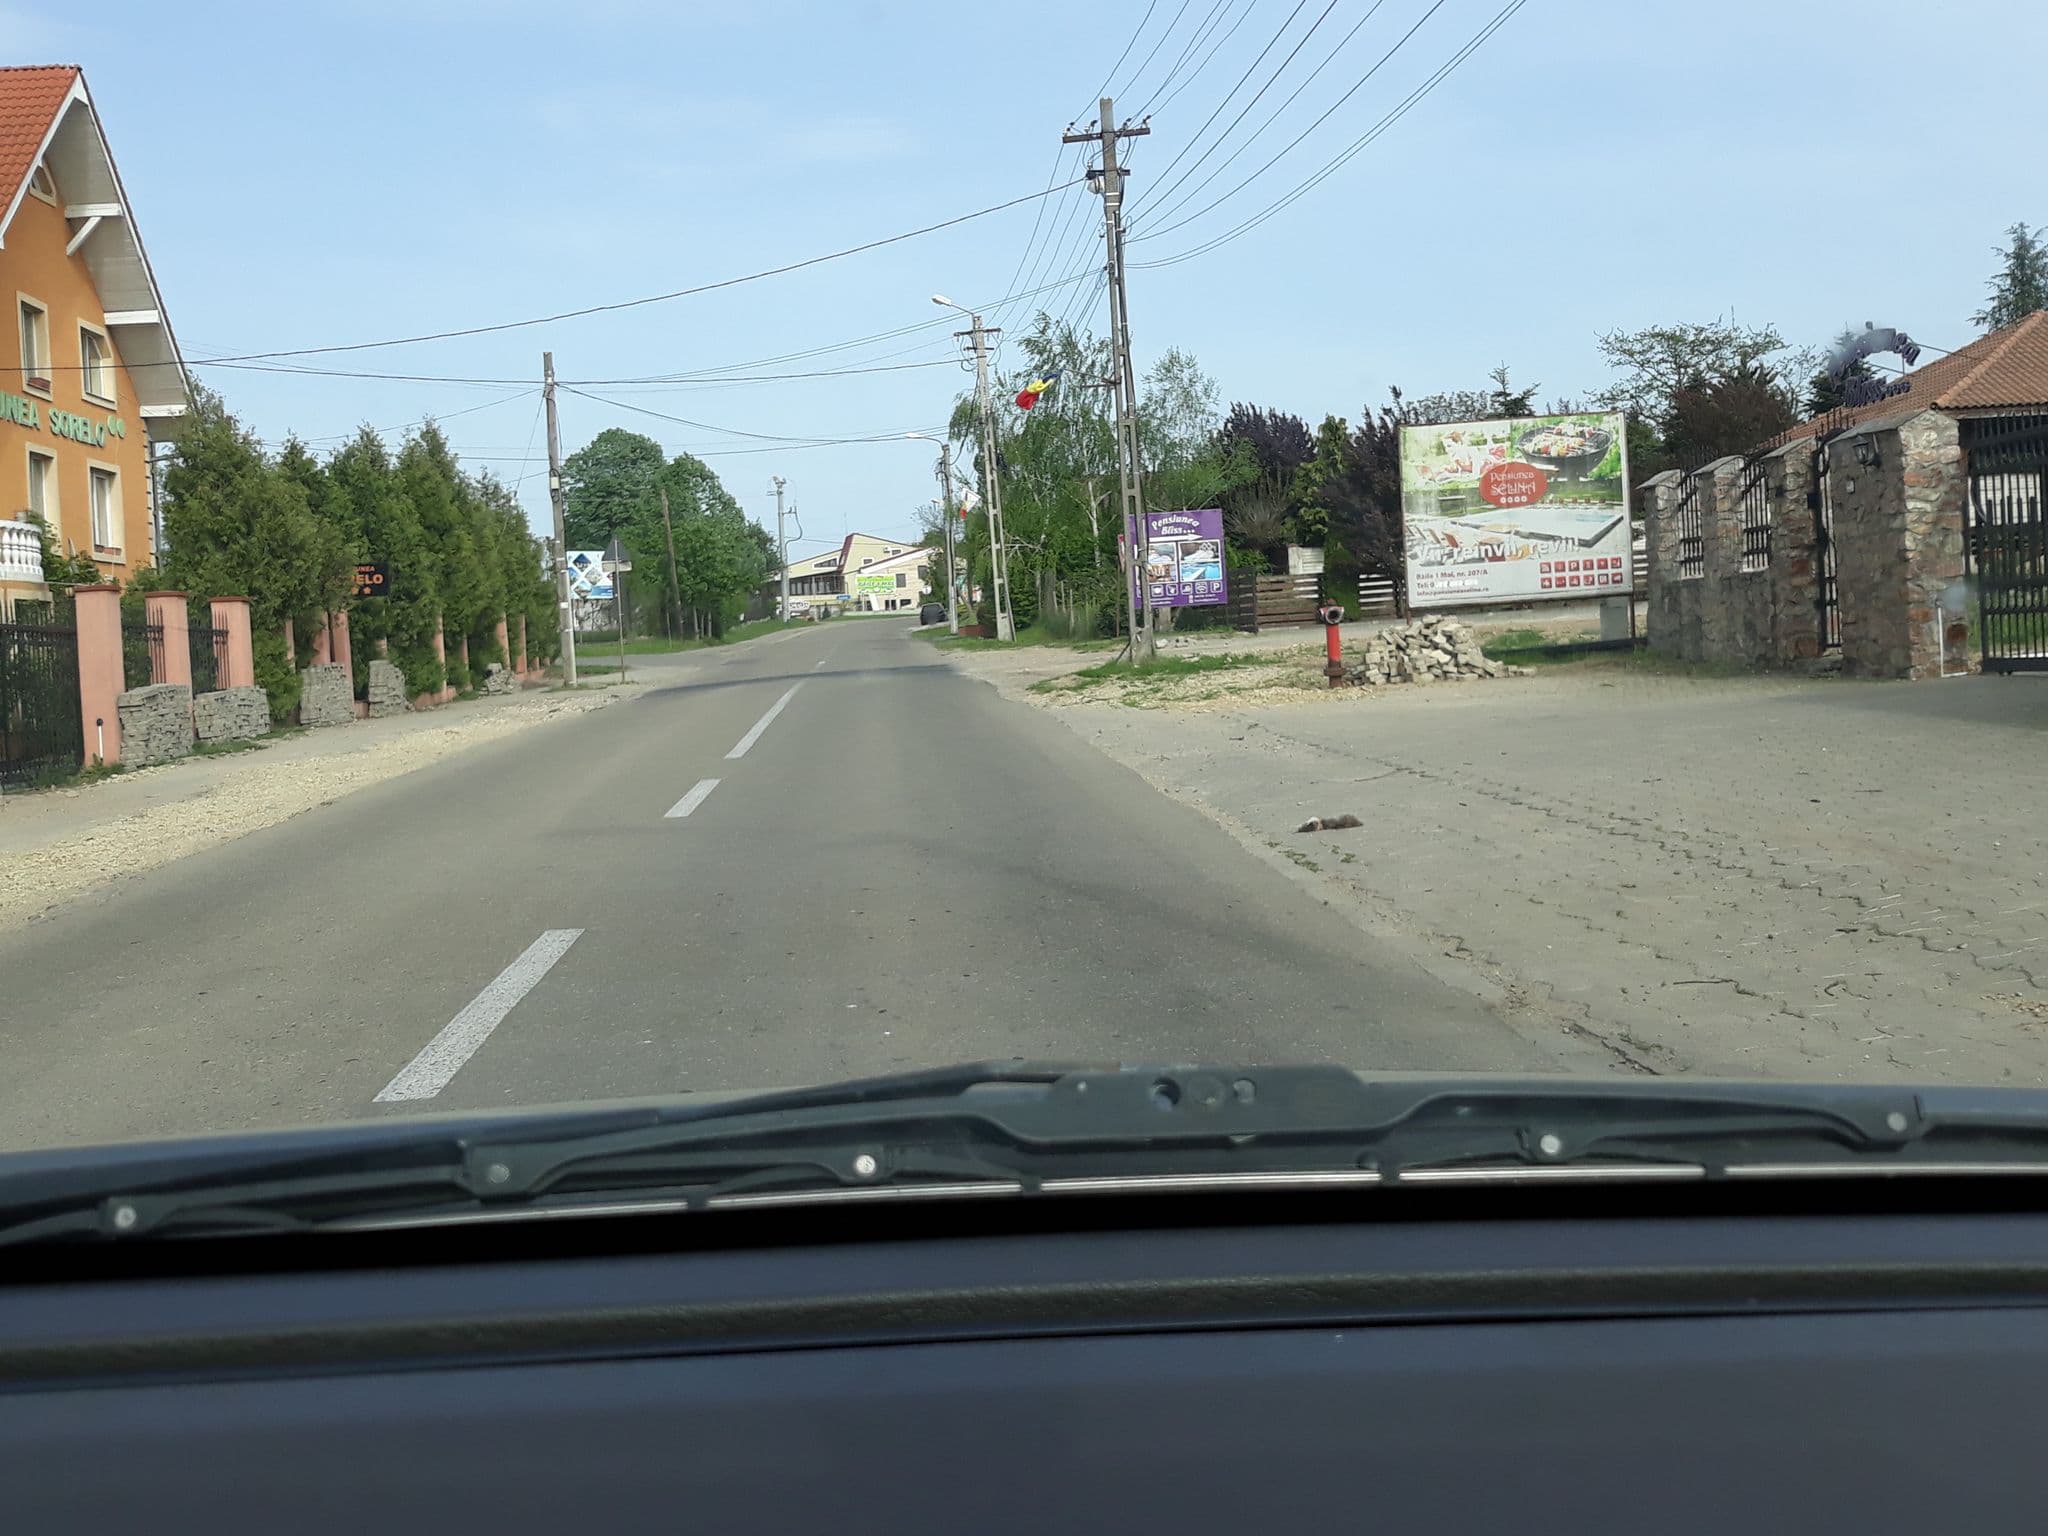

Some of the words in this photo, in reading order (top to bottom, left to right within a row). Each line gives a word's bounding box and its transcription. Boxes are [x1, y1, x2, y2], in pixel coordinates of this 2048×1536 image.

[49, 408, 105, 447] SORELO
[1490, 471, 1535, 483] Pensiunea
[1151, 514, 1200, 531] Pensiunea
